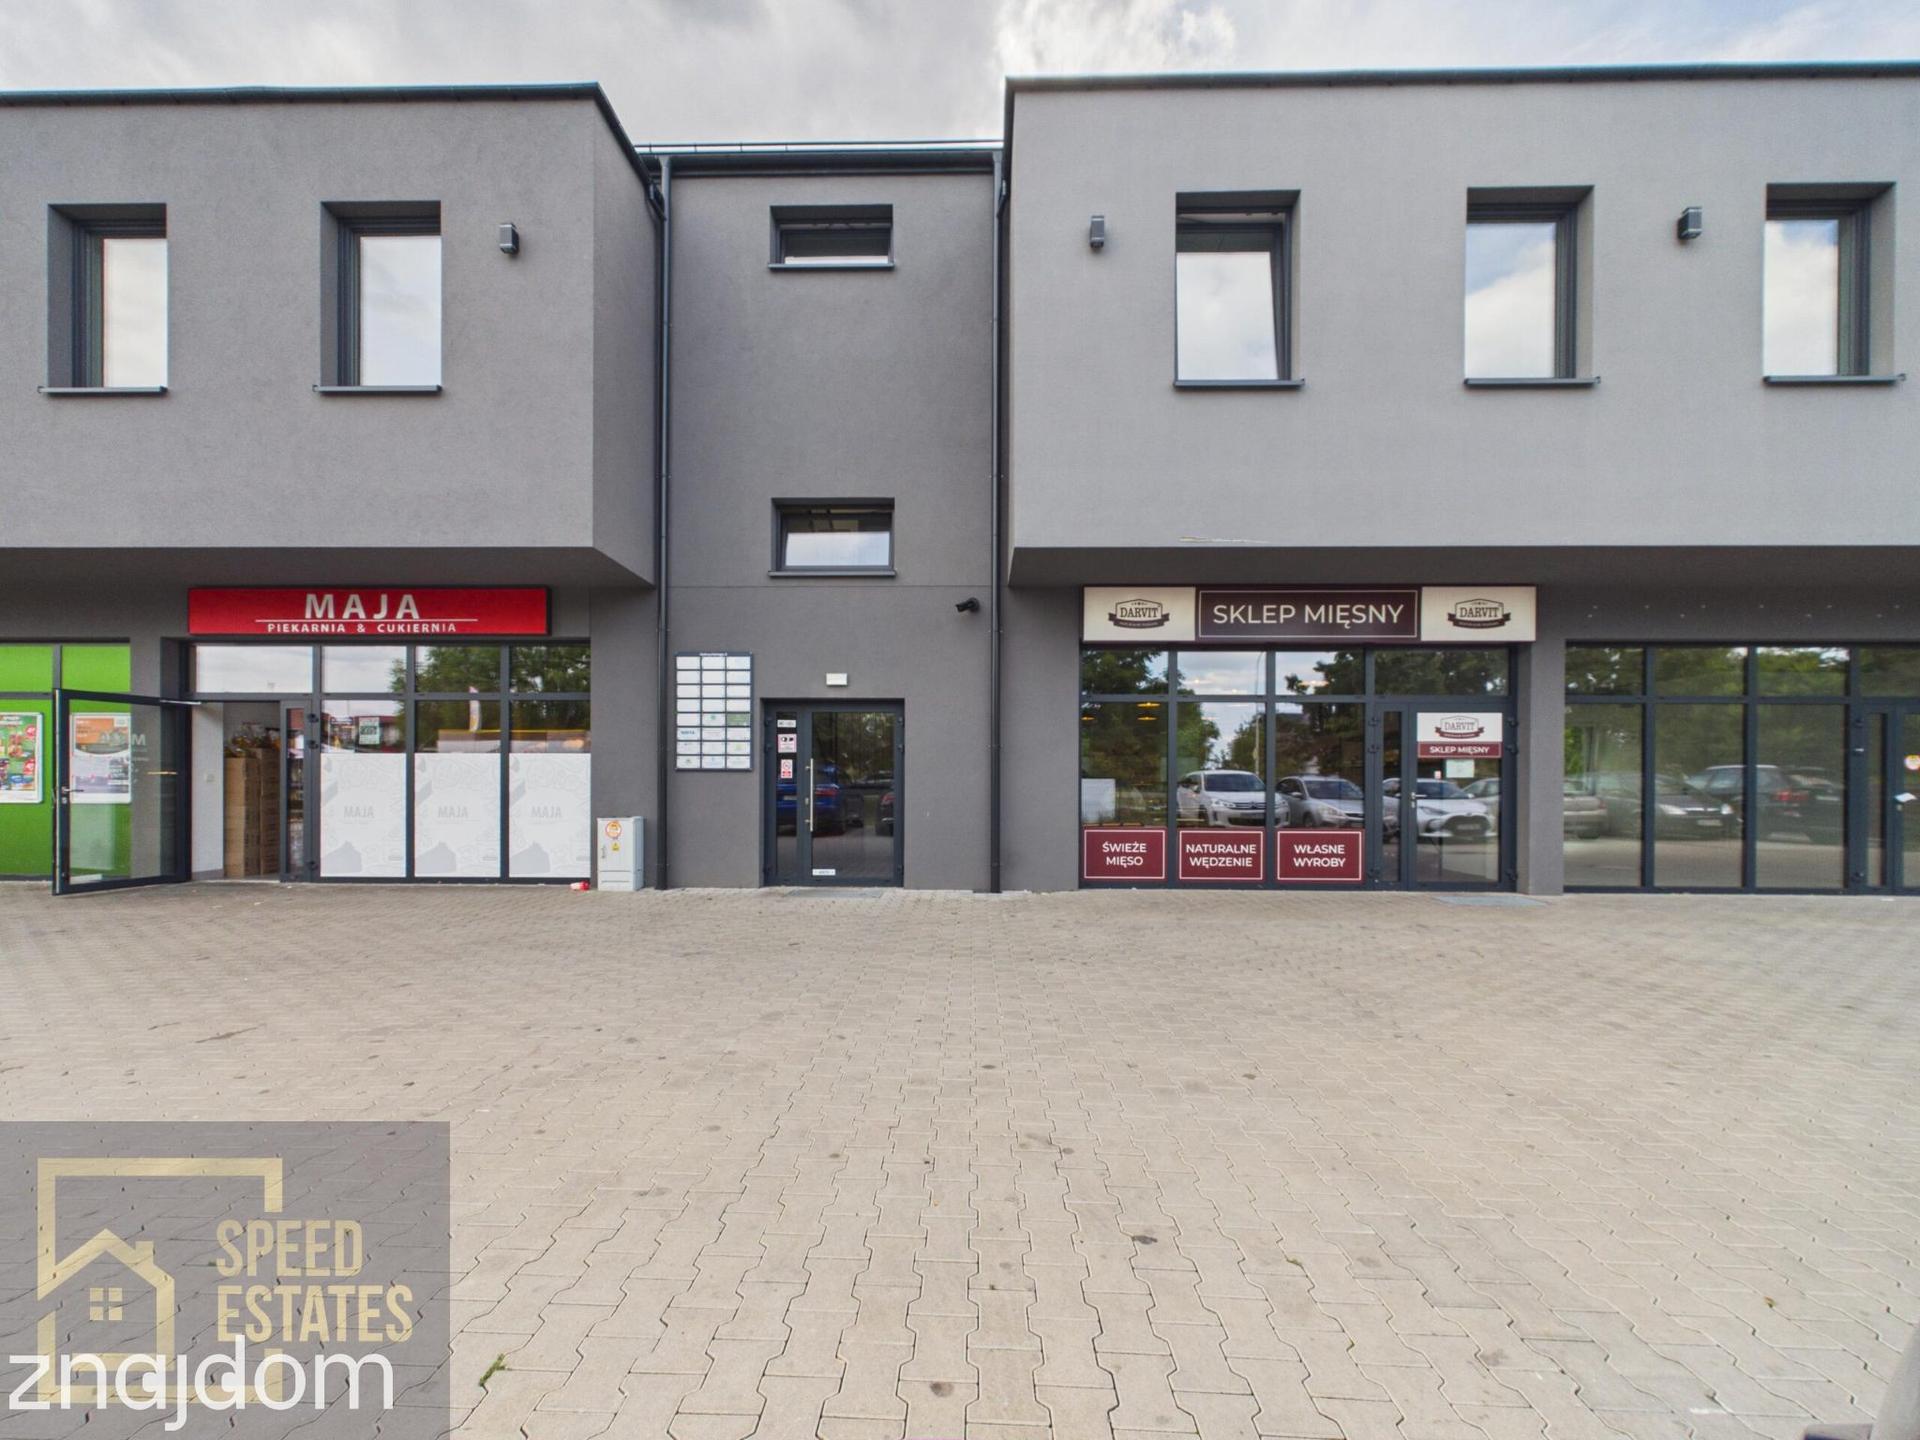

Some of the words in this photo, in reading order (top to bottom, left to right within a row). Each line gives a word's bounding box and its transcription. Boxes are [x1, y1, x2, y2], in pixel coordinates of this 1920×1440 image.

[305, 593, 420, 619] MAJA
[1120, 607, 1159, 618] DARVIT
[1213, 604, 1296, 624] SKLEP
[1304, 604, 1404, 629] MIĘSNY
[1460, 607, 1499, 618] DARVIT
[267, 623, 346, 633] PIEKARNIA
[357, 623, 366, 633] &
[377, 623, 456, 633] CUKIERNIA
[1444, 722, 1475, 731] DARVIT
[1458, 746, 1490, 754] MIĘSNY
[1102, 841, 1147, 853] ŚWIEŻE
[1186, 843, 1257, 854] NATURALNE
[1294, 843, 1345, 854] WŁASNE
[1106, 856, 1144, 868] MIĘSO
[1189, 856, 1253, 869] WĘDZENIE
[1293, 857, 1346, 868] WYROBY
